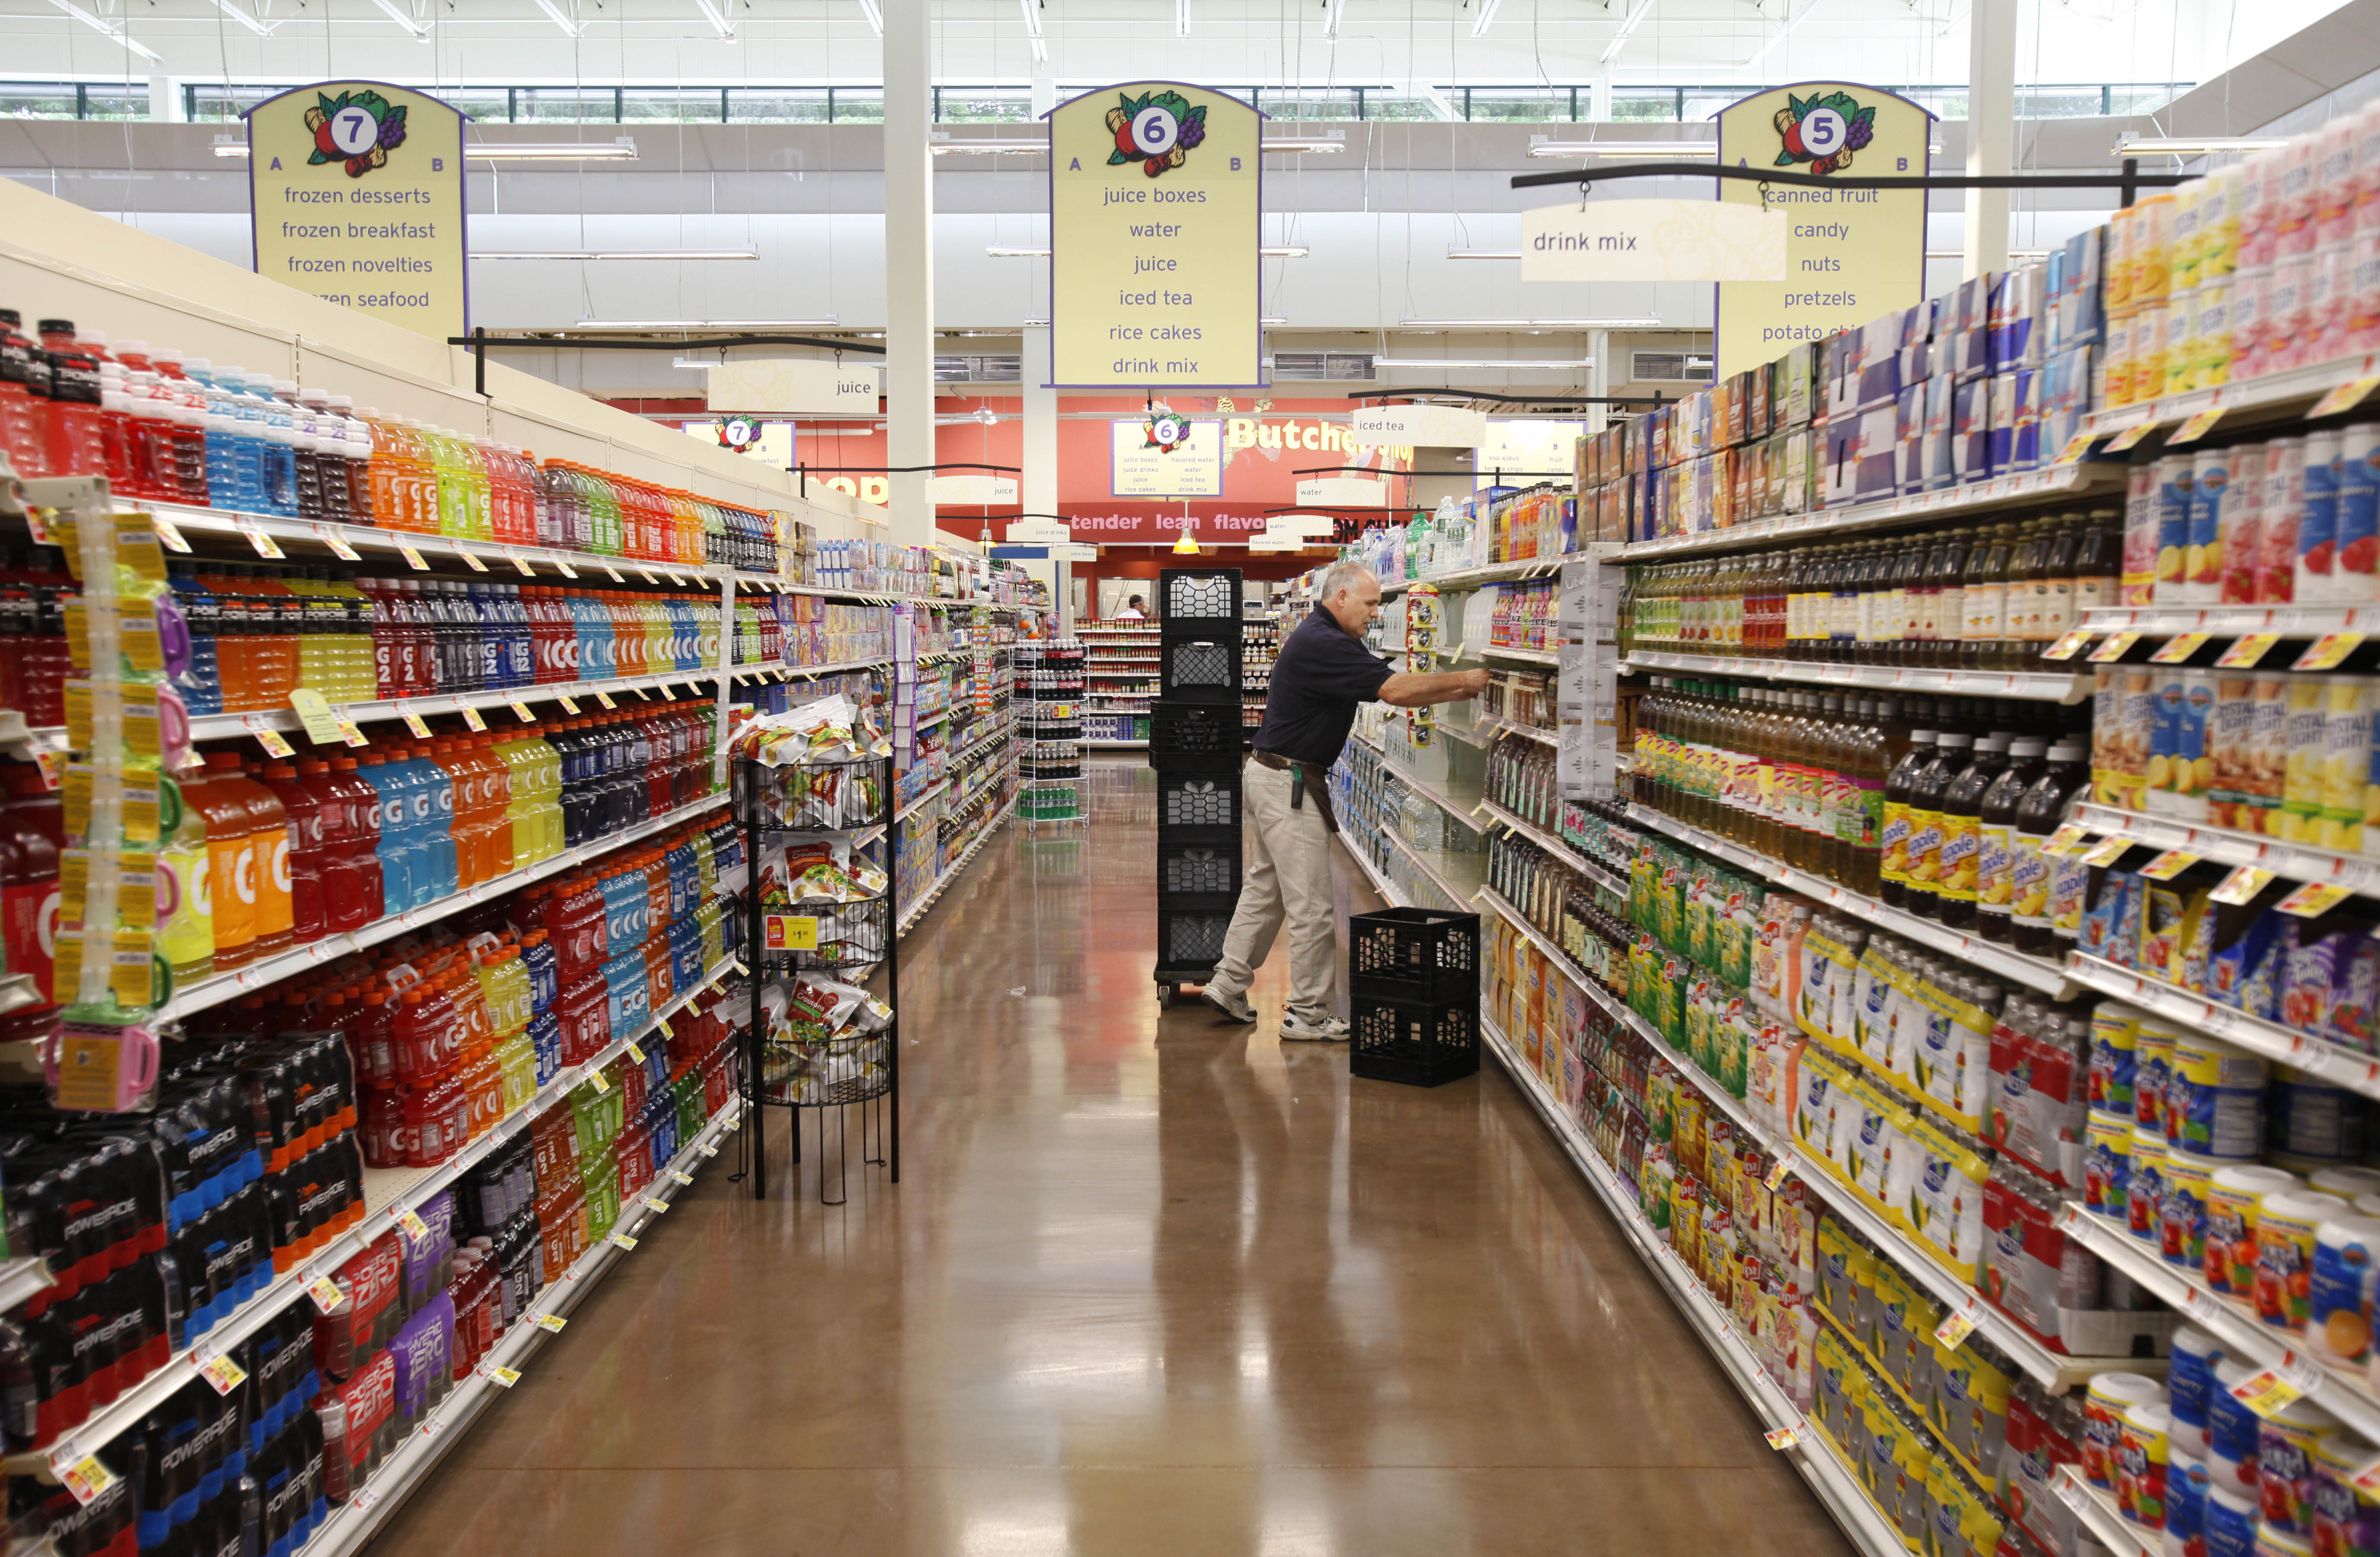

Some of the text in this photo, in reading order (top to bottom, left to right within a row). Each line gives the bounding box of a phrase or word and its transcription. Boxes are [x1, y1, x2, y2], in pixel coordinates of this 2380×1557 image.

[343, 115, 364, 143] 7
[1143, 115, 1165, 143] 6
[1812, 117, 1833, 144] 5
[270, 157, 282, 170] A
[432, 158, 443, 171] B
[1069, 158, 1081, 171] A
[1230, 158, 1241, 171] B
[1737, 158, 1748, 168] A
[1897, 158, 1908, 171] B
[285, 187, 431, 203] frozen desserts
[1103, 187, 1206, 206] juice boxes
[1766, 188, 1878, 203] canned fruit
[283, 222, 435, 238] frozen breakfast
[1130, 223, 1182, 237] water
[1795, 222, 1849, 240] candy
[1534, 232, 1637, 251] drink mix
[289, 257, 433, 273] frozen novelties
[1134, 256, 1177, 274] juice
[1802, 257, 1840, 271] nuts
[358, 292, 429, 307] seafood
[1120, 290, 1192, 305] iced tea
[1785, 291, 1856, 308] pretzels
[1110, 324, 1202, 340] rice cakes
[1763, 325, 1822, 342] potato
[1113, 358, 1198, 373] drink mix
[836, 380, 871, 395] juice
[733, 426, 744, 440] 7
[1161, 424, 1172, 438] 6
[1359, 420, 1404, 431] iced tea
[1228, 418, 1367, 454] Butche
[994, 486, 1013, 496] juice
[1071, 515, 1266, 530] tender lean flavo
[797, 992, 825, 1011] Croutons
